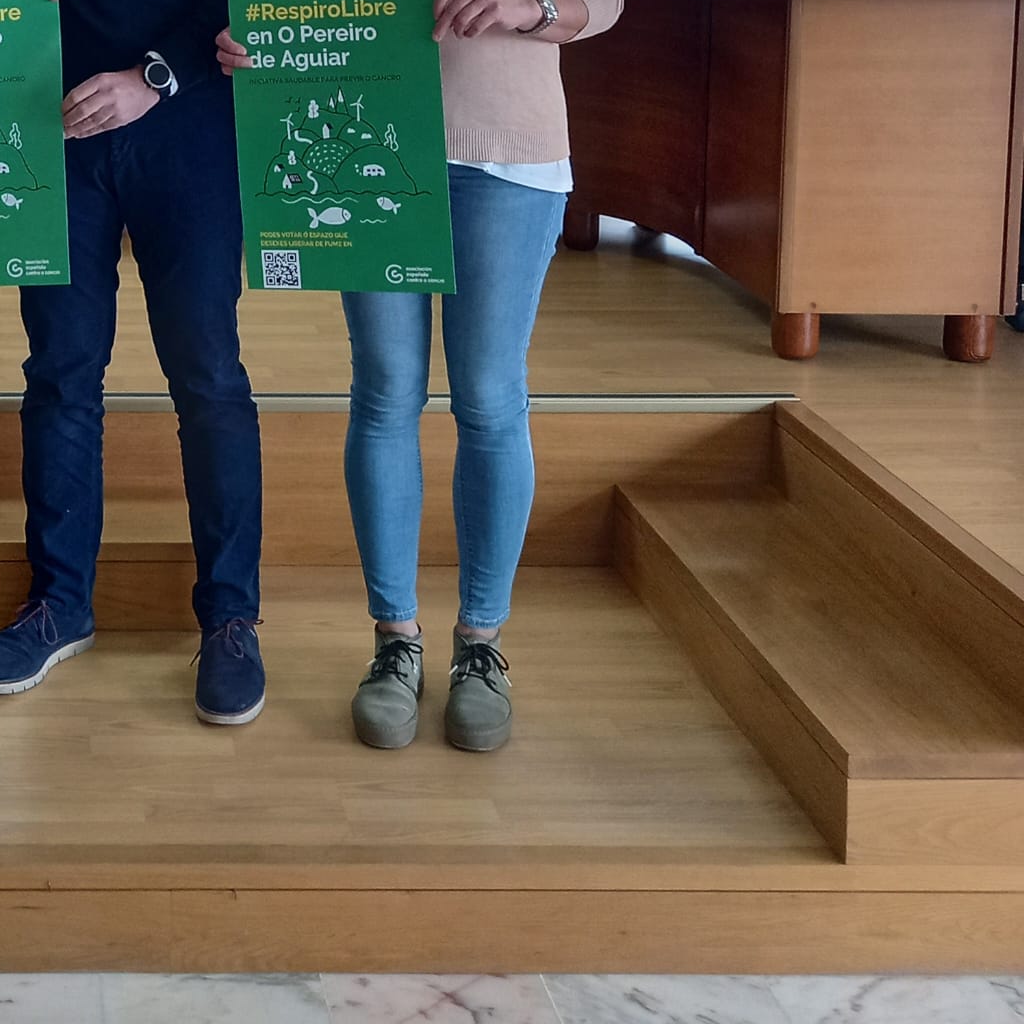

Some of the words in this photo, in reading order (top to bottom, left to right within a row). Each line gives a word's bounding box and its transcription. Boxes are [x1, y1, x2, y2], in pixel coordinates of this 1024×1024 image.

[247, 30, 273, 45] en
[278, 26, 295, 43] O
[300, 23, 377, 43] Pereiro
[251, 51, 275, 69] de
[280, 48, 350, 72] Aguiar
